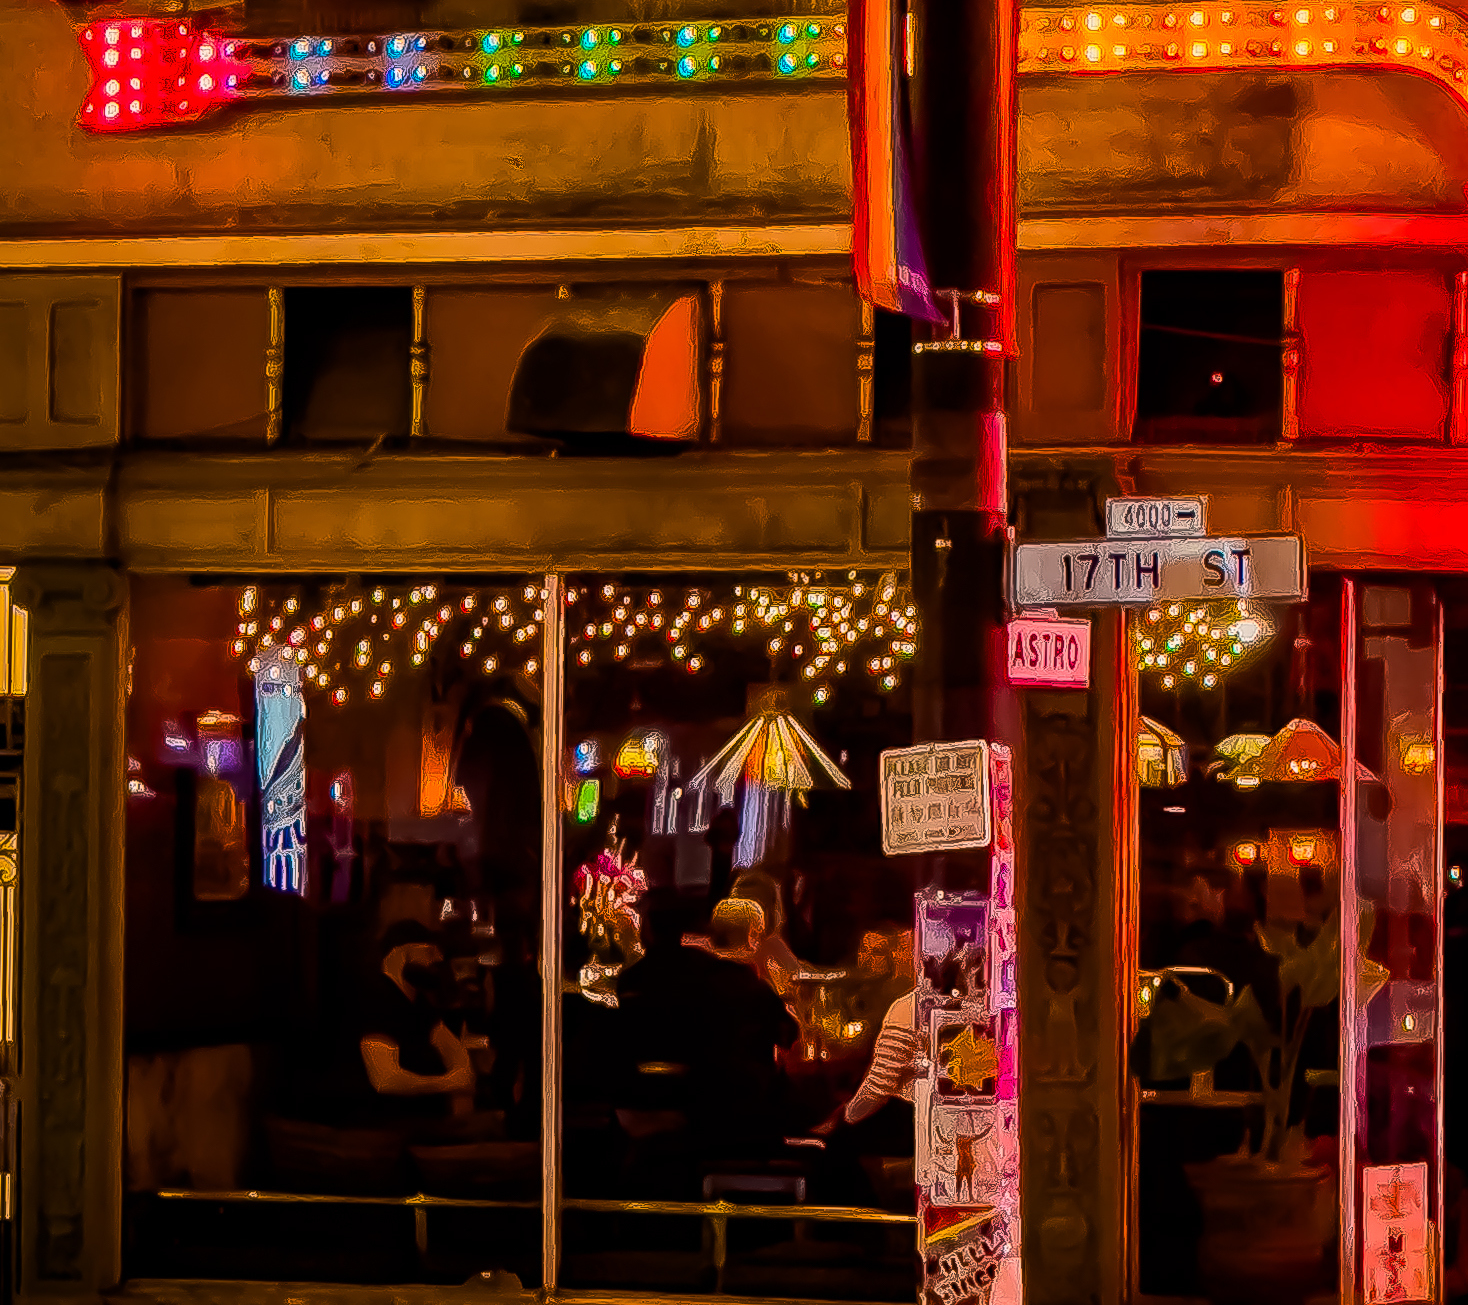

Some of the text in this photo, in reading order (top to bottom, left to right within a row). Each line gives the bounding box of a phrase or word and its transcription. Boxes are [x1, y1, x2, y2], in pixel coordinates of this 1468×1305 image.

[1124, 503, 1172, 529] 4000
[1062, 548, 1251, 592] 17TH ST
